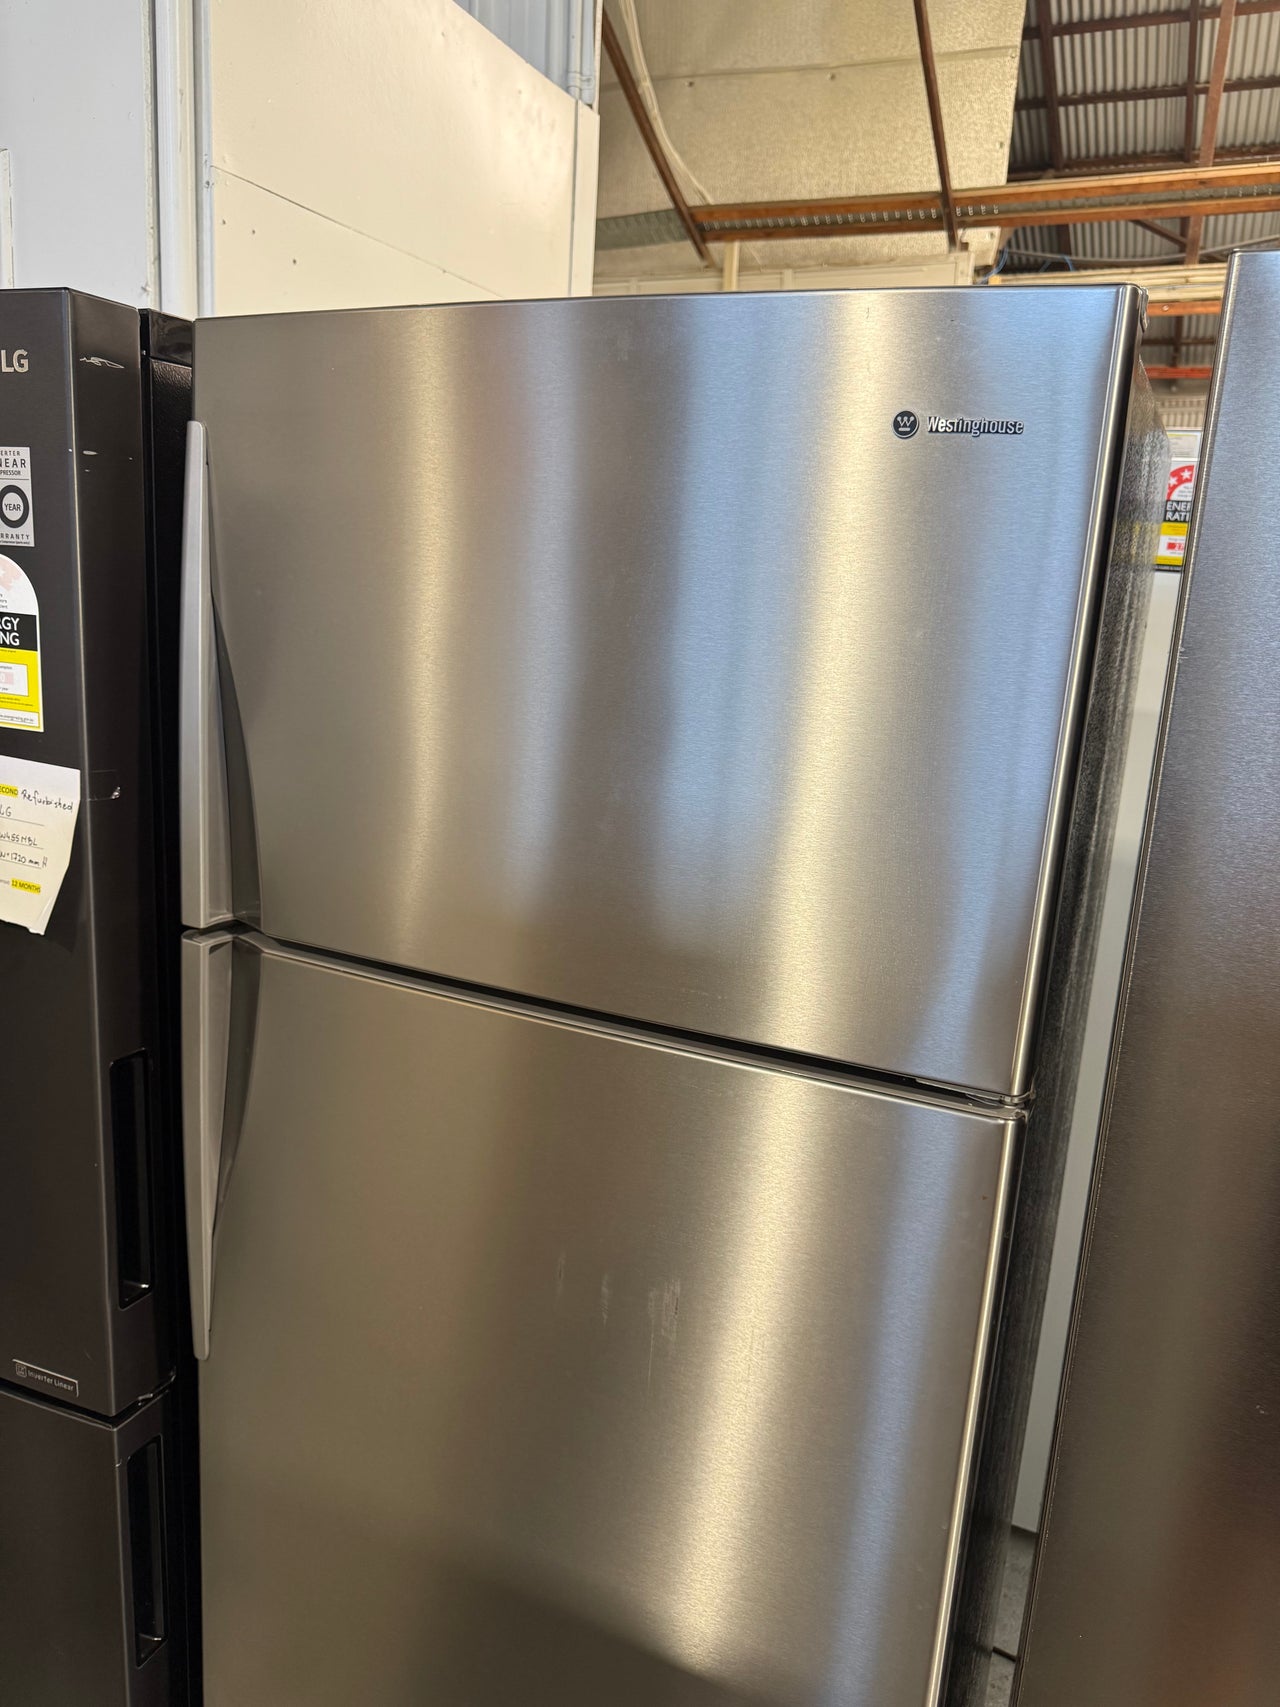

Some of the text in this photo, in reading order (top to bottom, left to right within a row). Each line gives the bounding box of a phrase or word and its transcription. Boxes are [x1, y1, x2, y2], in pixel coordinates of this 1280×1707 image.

[1, 349, 29, 373] LG
[928, 416, 1025, 437] Westinghouse
[4, 503, 21, 512] YEAR
[19, 881, 41, 893] MONTHS
[27, 1370, 53, 1384] Inverter
[53, 1378, 74, 1391] Linear
